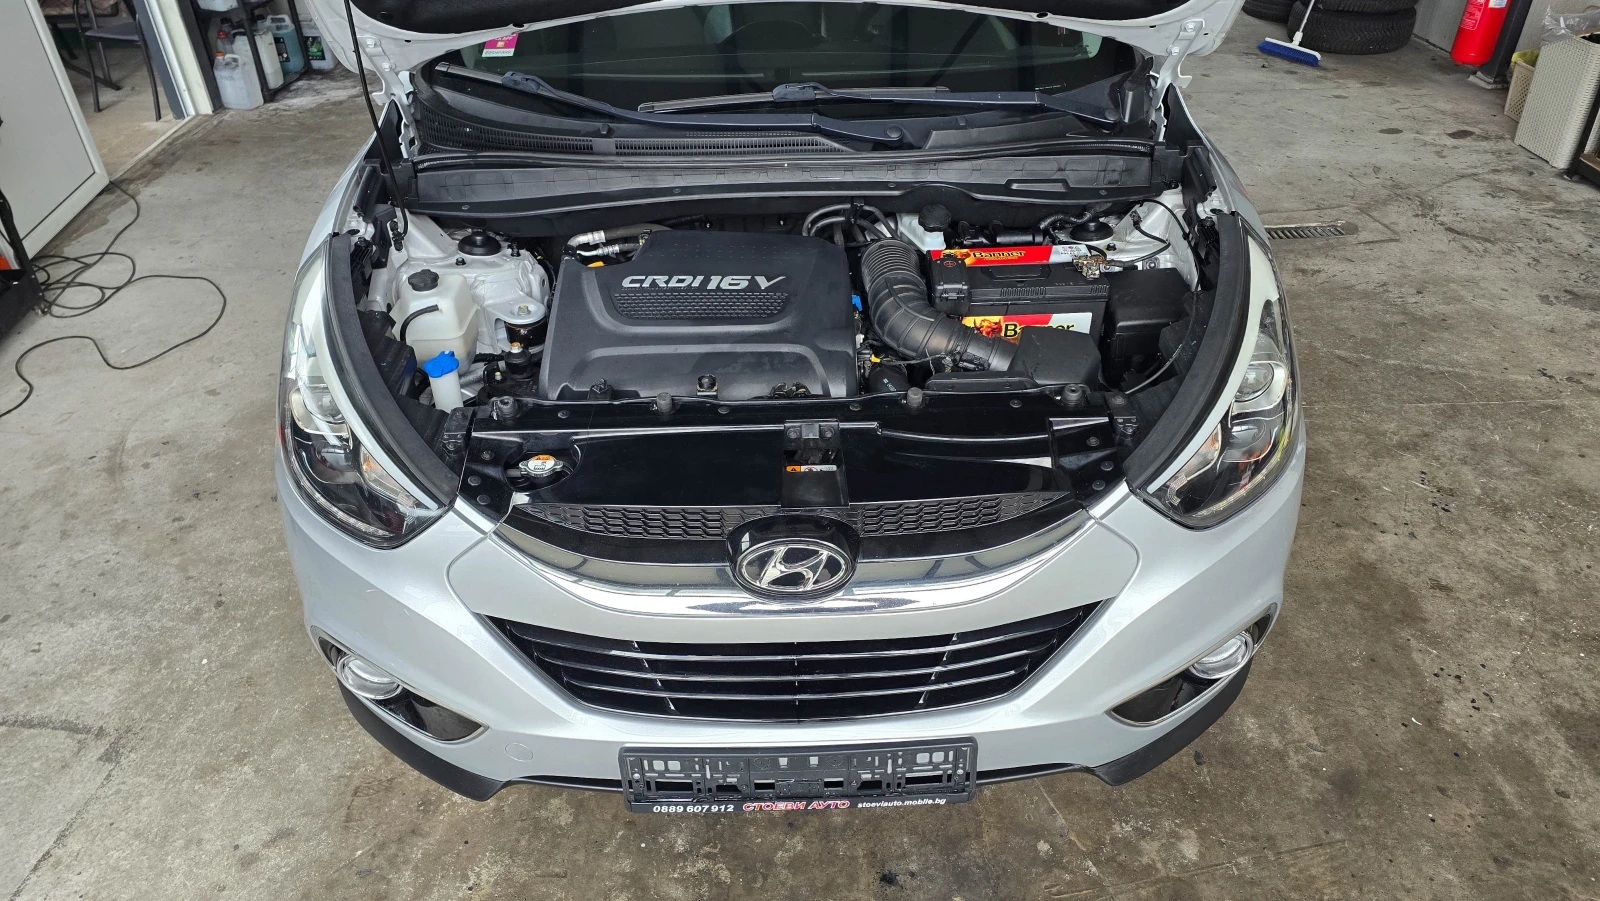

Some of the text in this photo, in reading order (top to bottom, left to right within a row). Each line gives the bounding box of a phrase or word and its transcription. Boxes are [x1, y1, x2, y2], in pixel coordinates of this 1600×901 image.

[972, 250, 1026, 259] Banner
[621, 275, 704, 289] CRDI
[743, 801, 807, 811] СТОЕВИ
[857, 797, 947, 808] stoeviauto.mobile.bg
[653, 804, 735, 813] 0889 607 912
